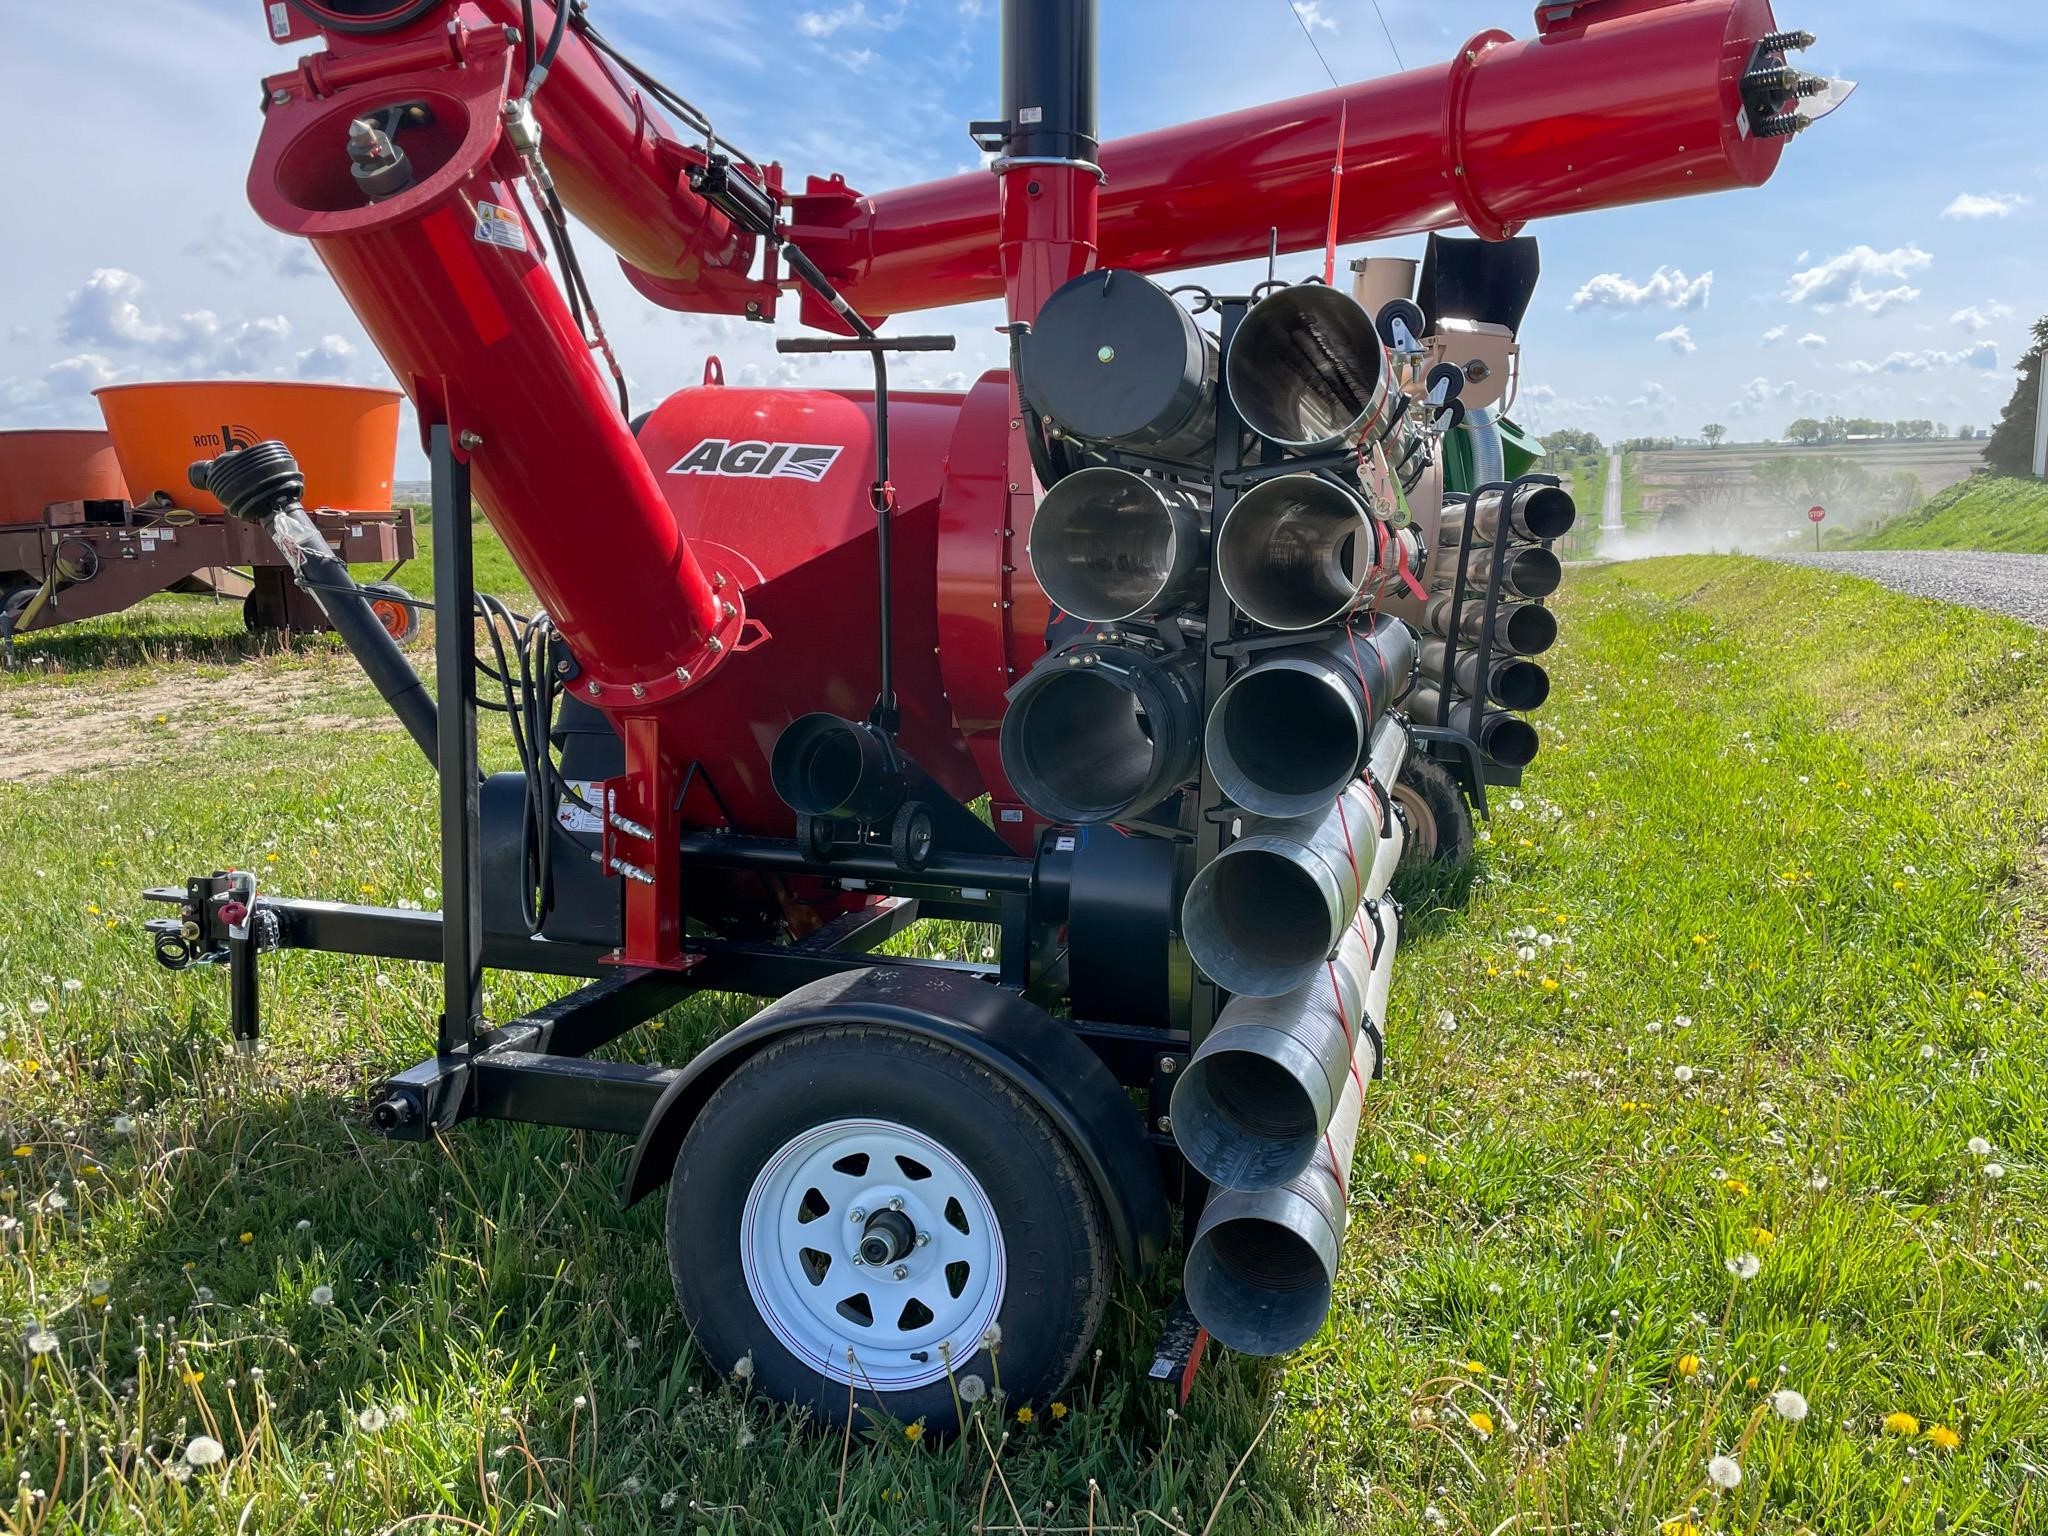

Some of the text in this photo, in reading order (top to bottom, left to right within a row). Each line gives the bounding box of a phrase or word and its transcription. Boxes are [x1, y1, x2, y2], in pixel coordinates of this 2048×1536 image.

[193, 434, 220, 448] ROTO
[673, 441, 790, 476] AGI
[1809, 510, 1825, 519] STOP
